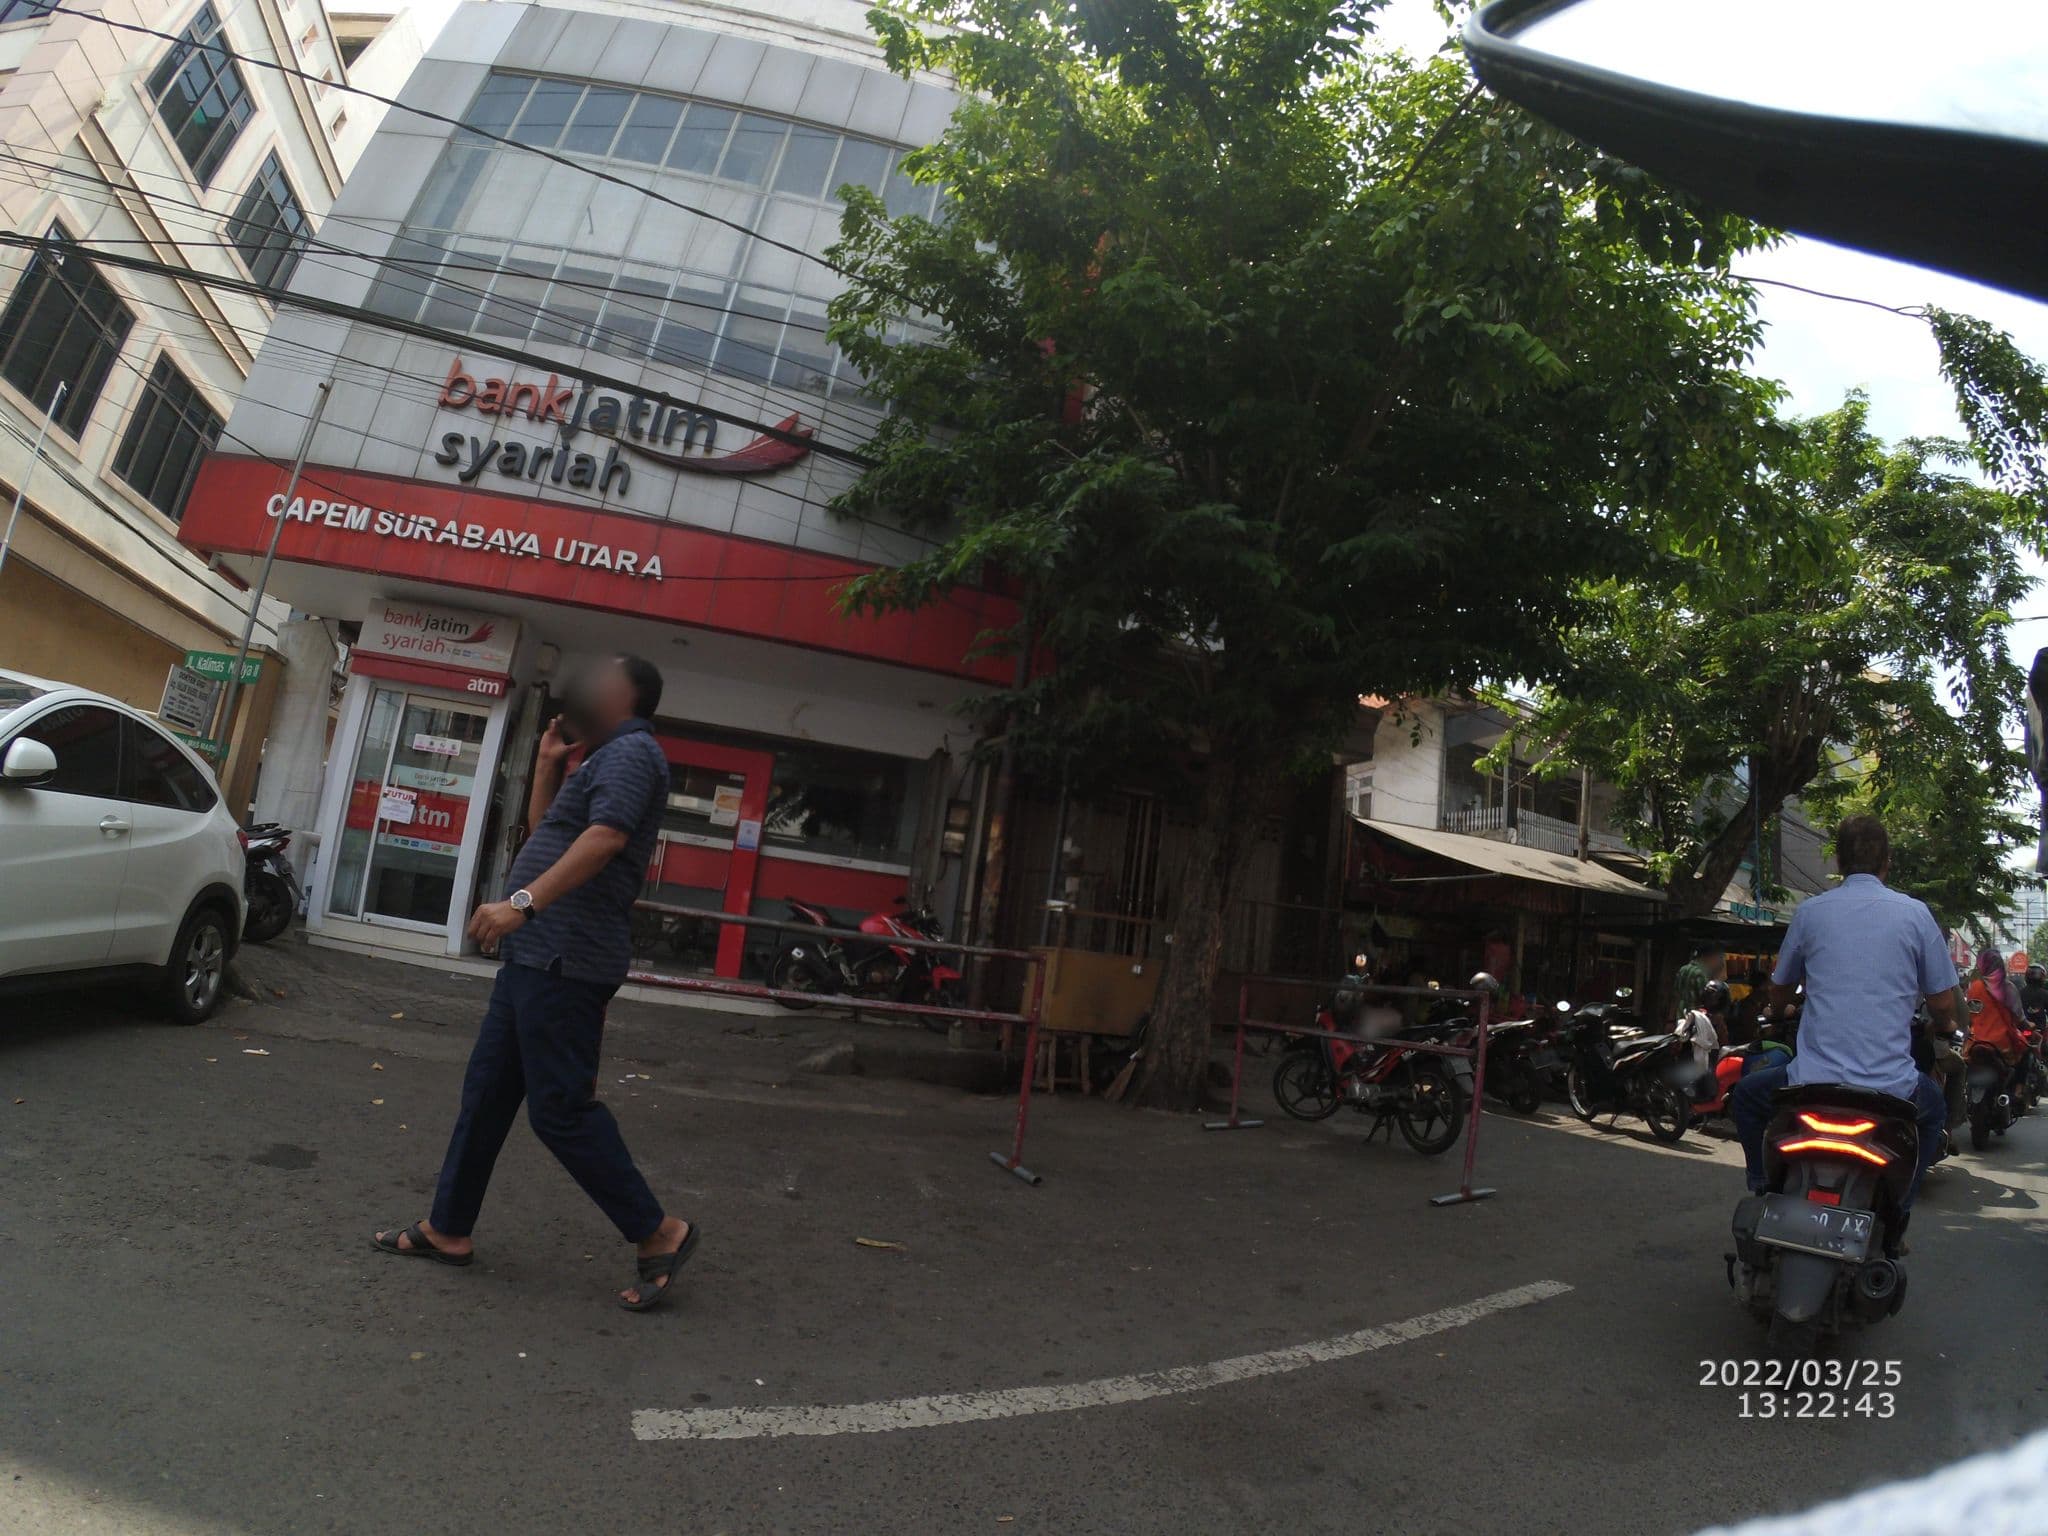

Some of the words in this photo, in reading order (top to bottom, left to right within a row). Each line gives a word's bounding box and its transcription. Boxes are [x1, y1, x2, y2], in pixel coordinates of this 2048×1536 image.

[435, 431, 631, 495] syariah
[266, 493, 372, 531] CAPEM
[373, 510, 541, 559] SURABAYA
[553, 537, 663, 581] UTARA
[382, 632, 445, 654] syariah
[196, 657, 225, 673] Kalimas
[467, 678, 499, 695] atm
[386, 789, 414, 801] TUTUP
[412, 804, 450, 828] tm
